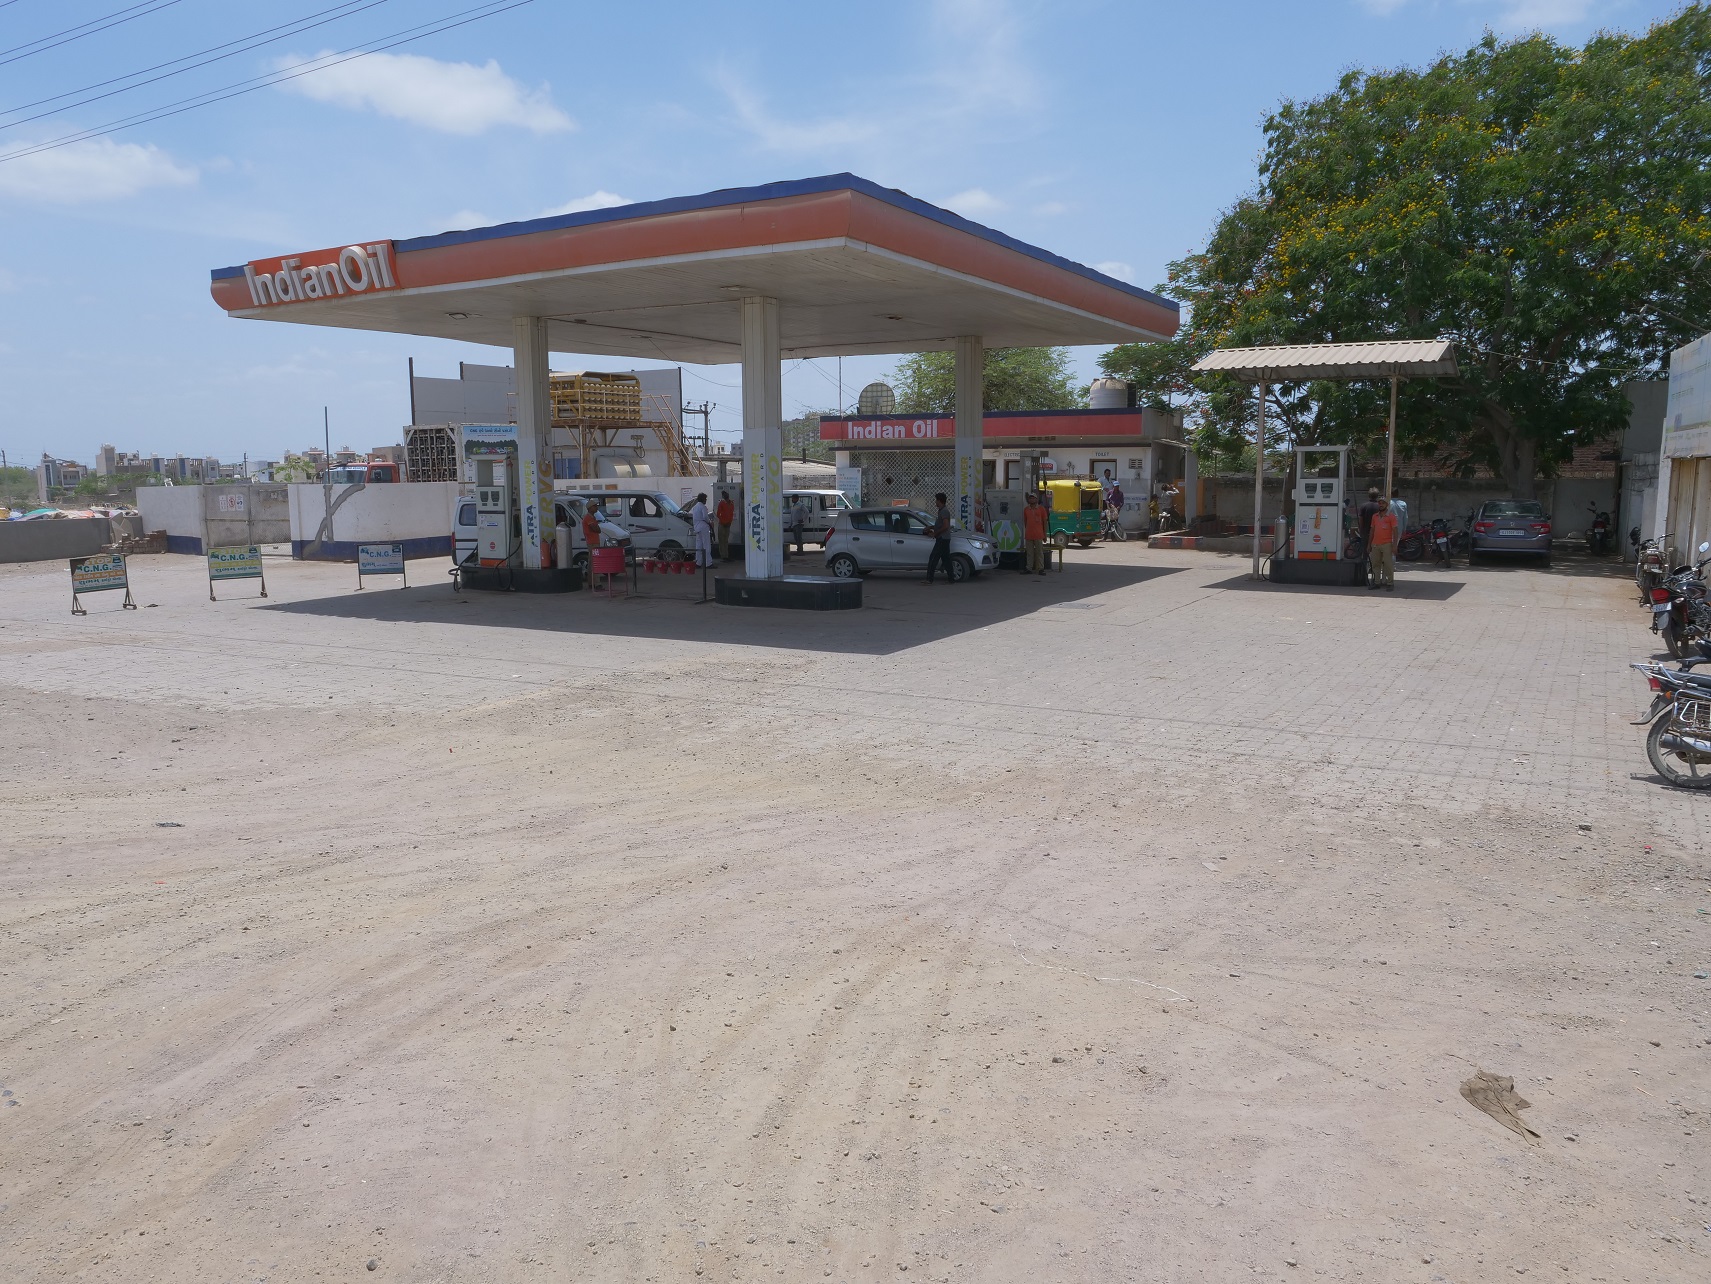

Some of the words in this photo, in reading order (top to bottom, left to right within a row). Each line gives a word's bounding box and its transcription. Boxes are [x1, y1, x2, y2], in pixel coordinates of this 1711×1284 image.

[847, 421, 906, 439] Indian
[912, 420, 938, 438] Oil
[220, 553, 248, 562] C.N.G.
[369, 550, 392, 559] C.N.G.
[83, 563, 112, 573] C.N.G.
